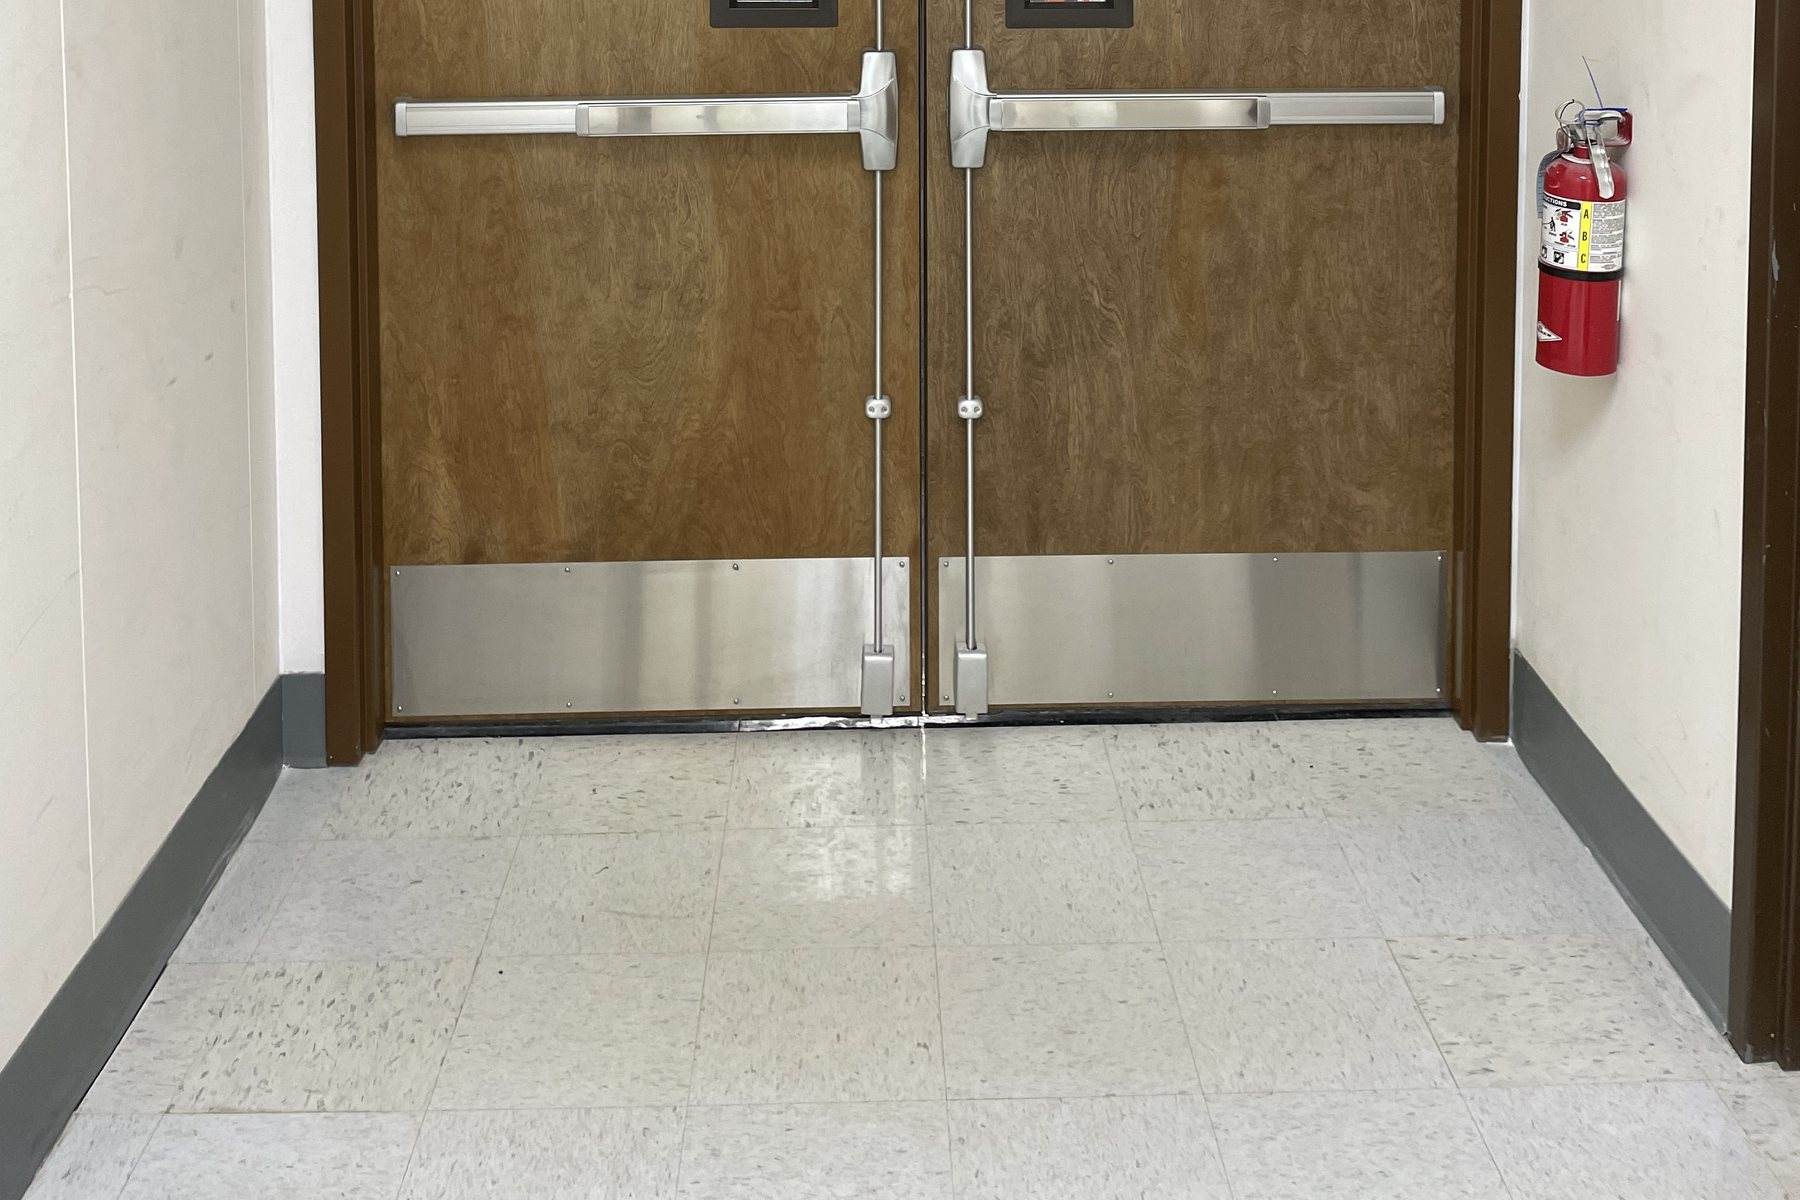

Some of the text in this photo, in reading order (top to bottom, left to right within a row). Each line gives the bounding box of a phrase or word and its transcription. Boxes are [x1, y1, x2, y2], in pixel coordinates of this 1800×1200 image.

[1583, 209, 1589, 219] A
[1582, 231, 1588, 242] B
[1580, 253, 1586, 264] C
